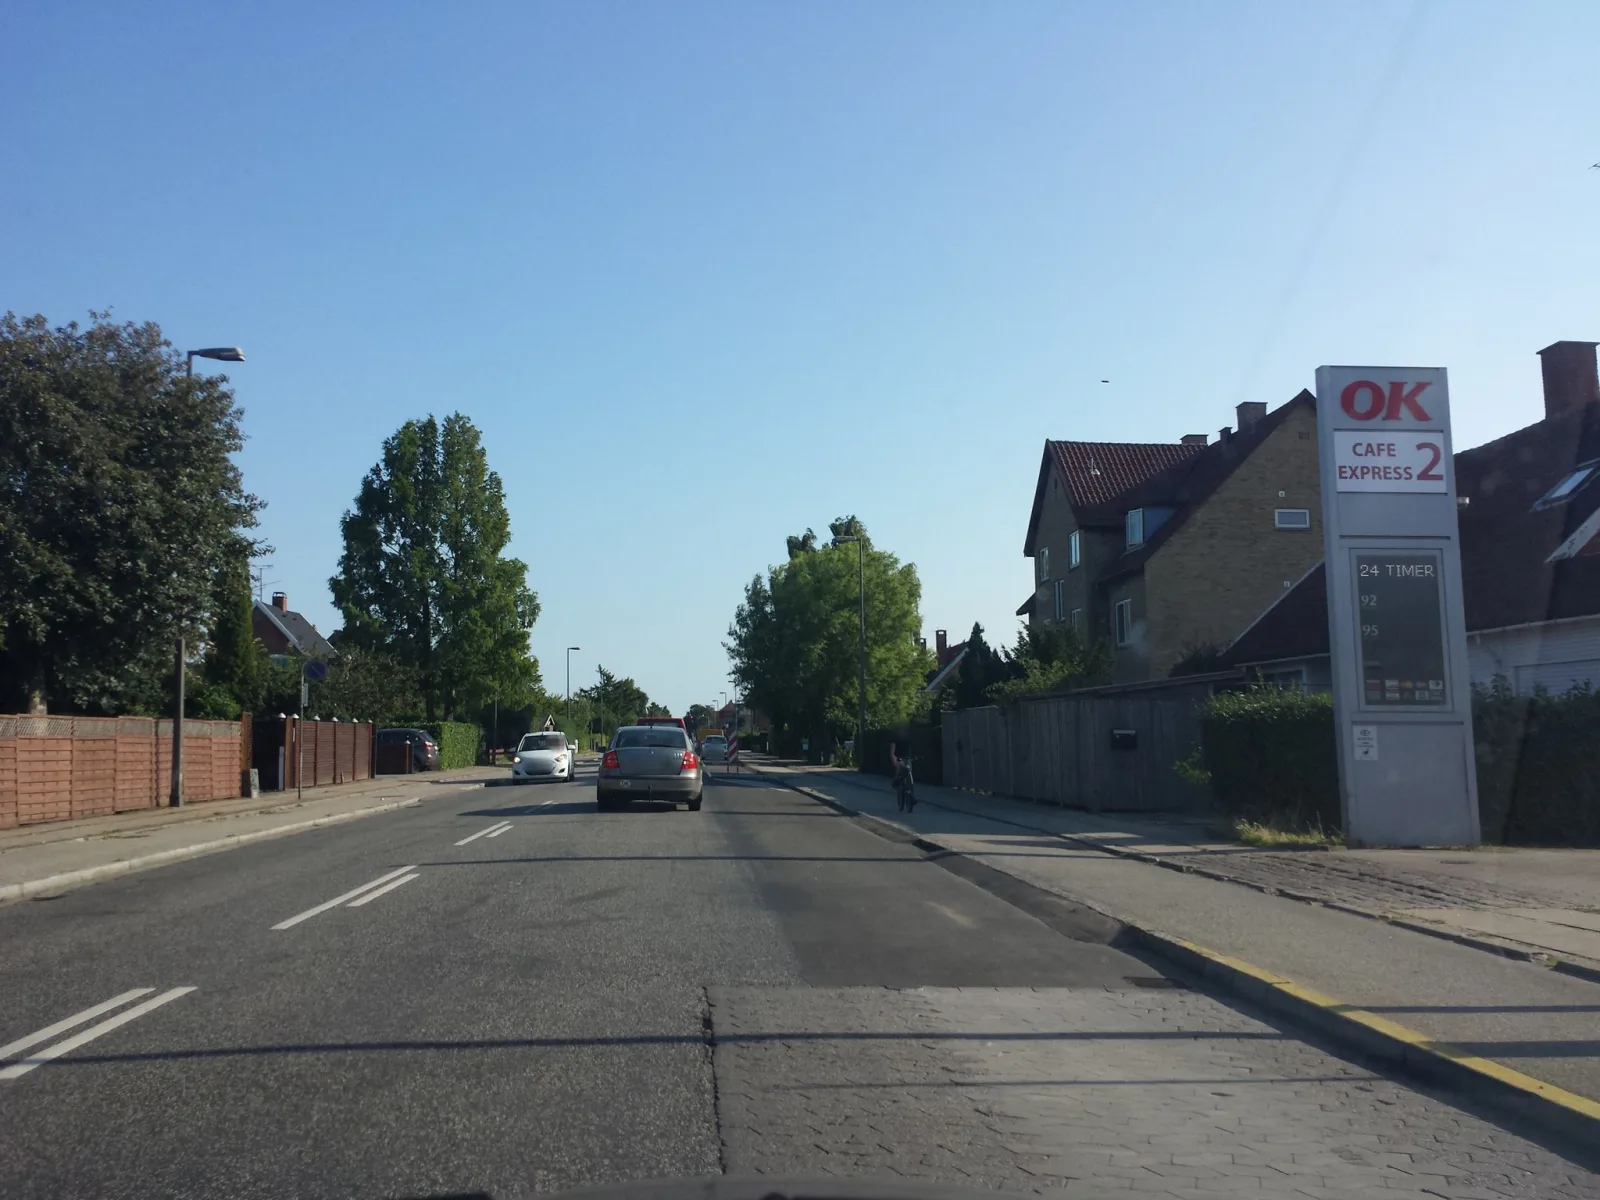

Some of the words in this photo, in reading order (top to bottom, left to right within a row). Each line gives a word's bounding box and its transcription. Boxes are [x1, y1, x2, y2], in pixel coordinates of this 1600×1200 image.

[1340, 380, 1433, 421] OK
[1352, 442, 1396, 457] CAFE
[1416, 442, 1444, 481] 2
[1338, 465, 1413, 480] EXPRESS
[1360, 564, 1379, 577] 24
[1386, 564, 1435, 577] TIMER
[1361, 594, 1377, 606] 92
[1362, 624, 1379, 636] 95
